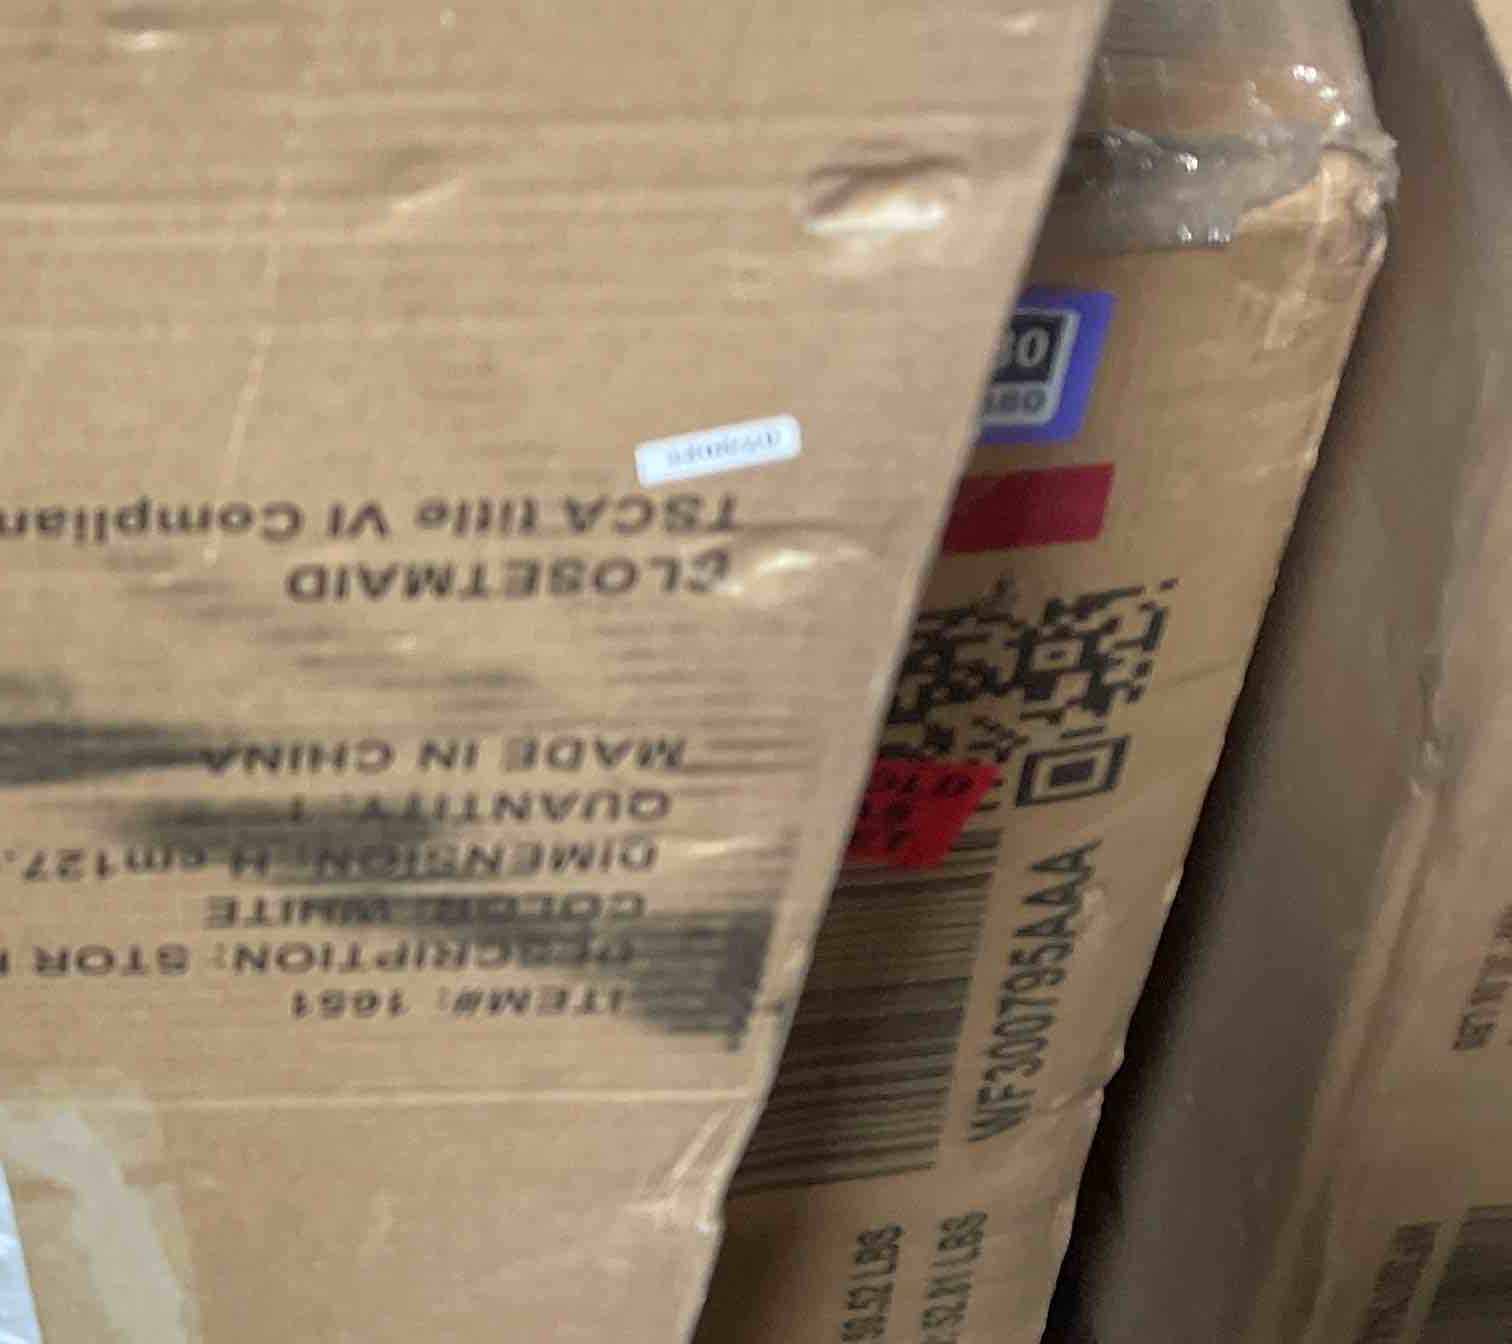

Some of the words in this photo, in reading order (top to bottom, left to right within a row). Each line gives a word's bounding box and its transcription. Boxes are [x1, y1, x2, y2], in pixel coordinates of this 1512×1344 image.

[326, 499, 389, 537] VI
[566, 494, 739, 535] TSCA
[287, 552, 732, 605] CLOSETMAID
[200, 738, 397, 776] CHINA
[419, 739, 482, 772] IN
[504, 738, 688, 774] MADE
[230, 849, 272, 879] H
[204, 894, 388, 929] WHITE
[31, 943, 191, 978] STOR
[290, 987, 405, 1020] 1651
